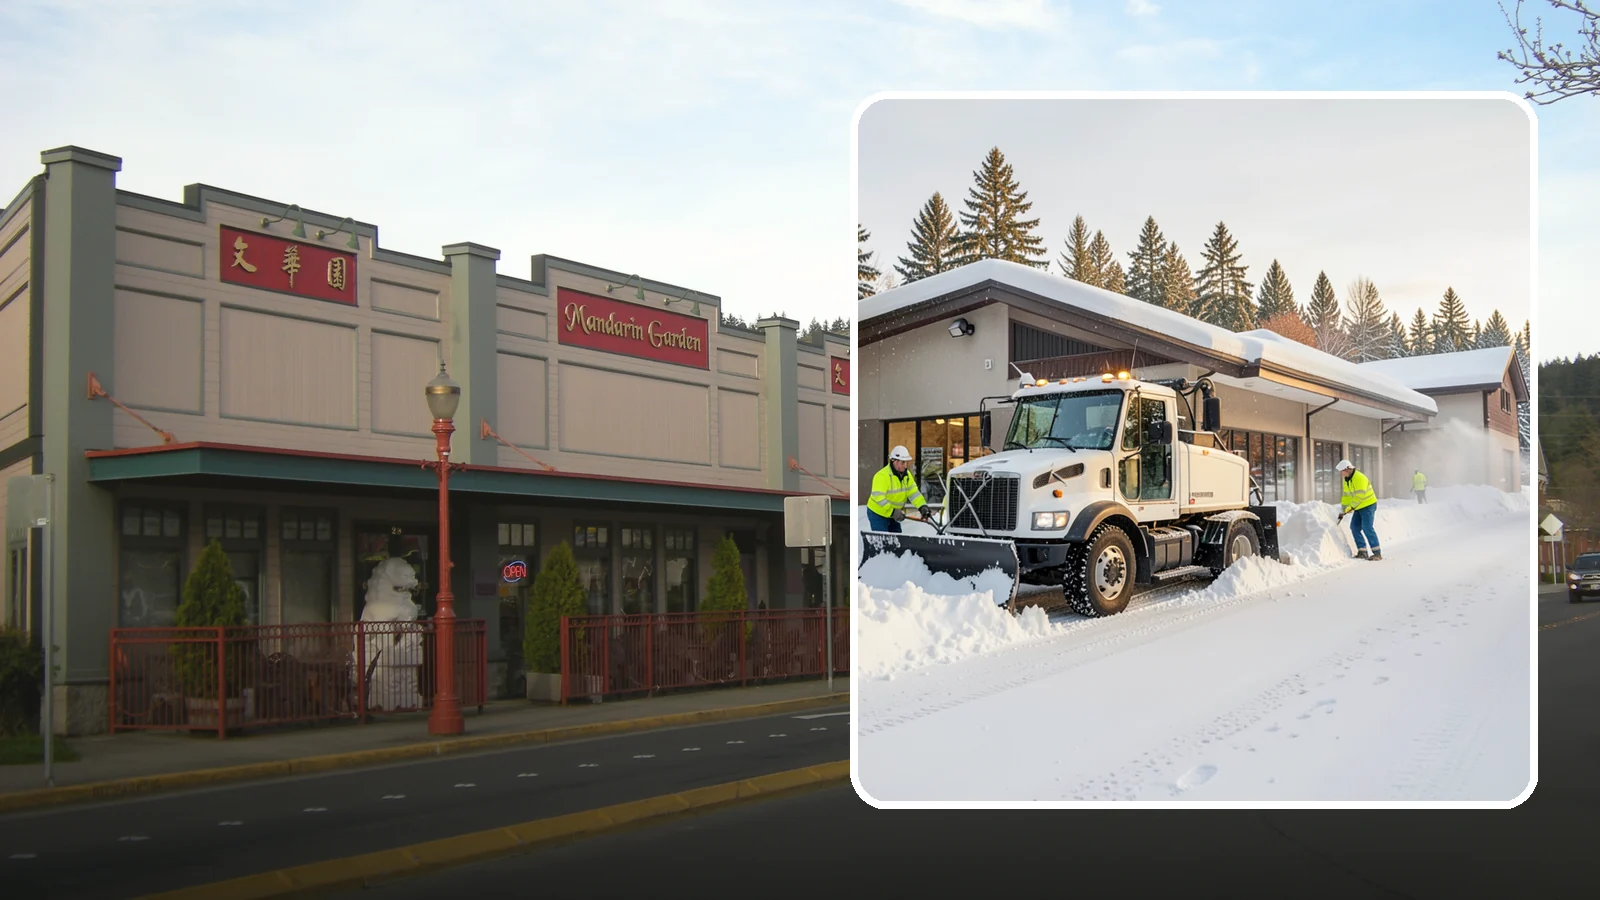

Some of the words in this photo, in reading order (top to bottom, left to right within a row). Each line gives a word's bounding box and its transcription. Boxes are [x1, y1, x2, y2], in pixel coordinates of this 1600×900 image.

[231, 235, 346, 290] 文華園
[564, 302, 644, 341] Mandarin
[648, 320, 701, 352] Garden
[503, 565, 527, 578] OPEN
